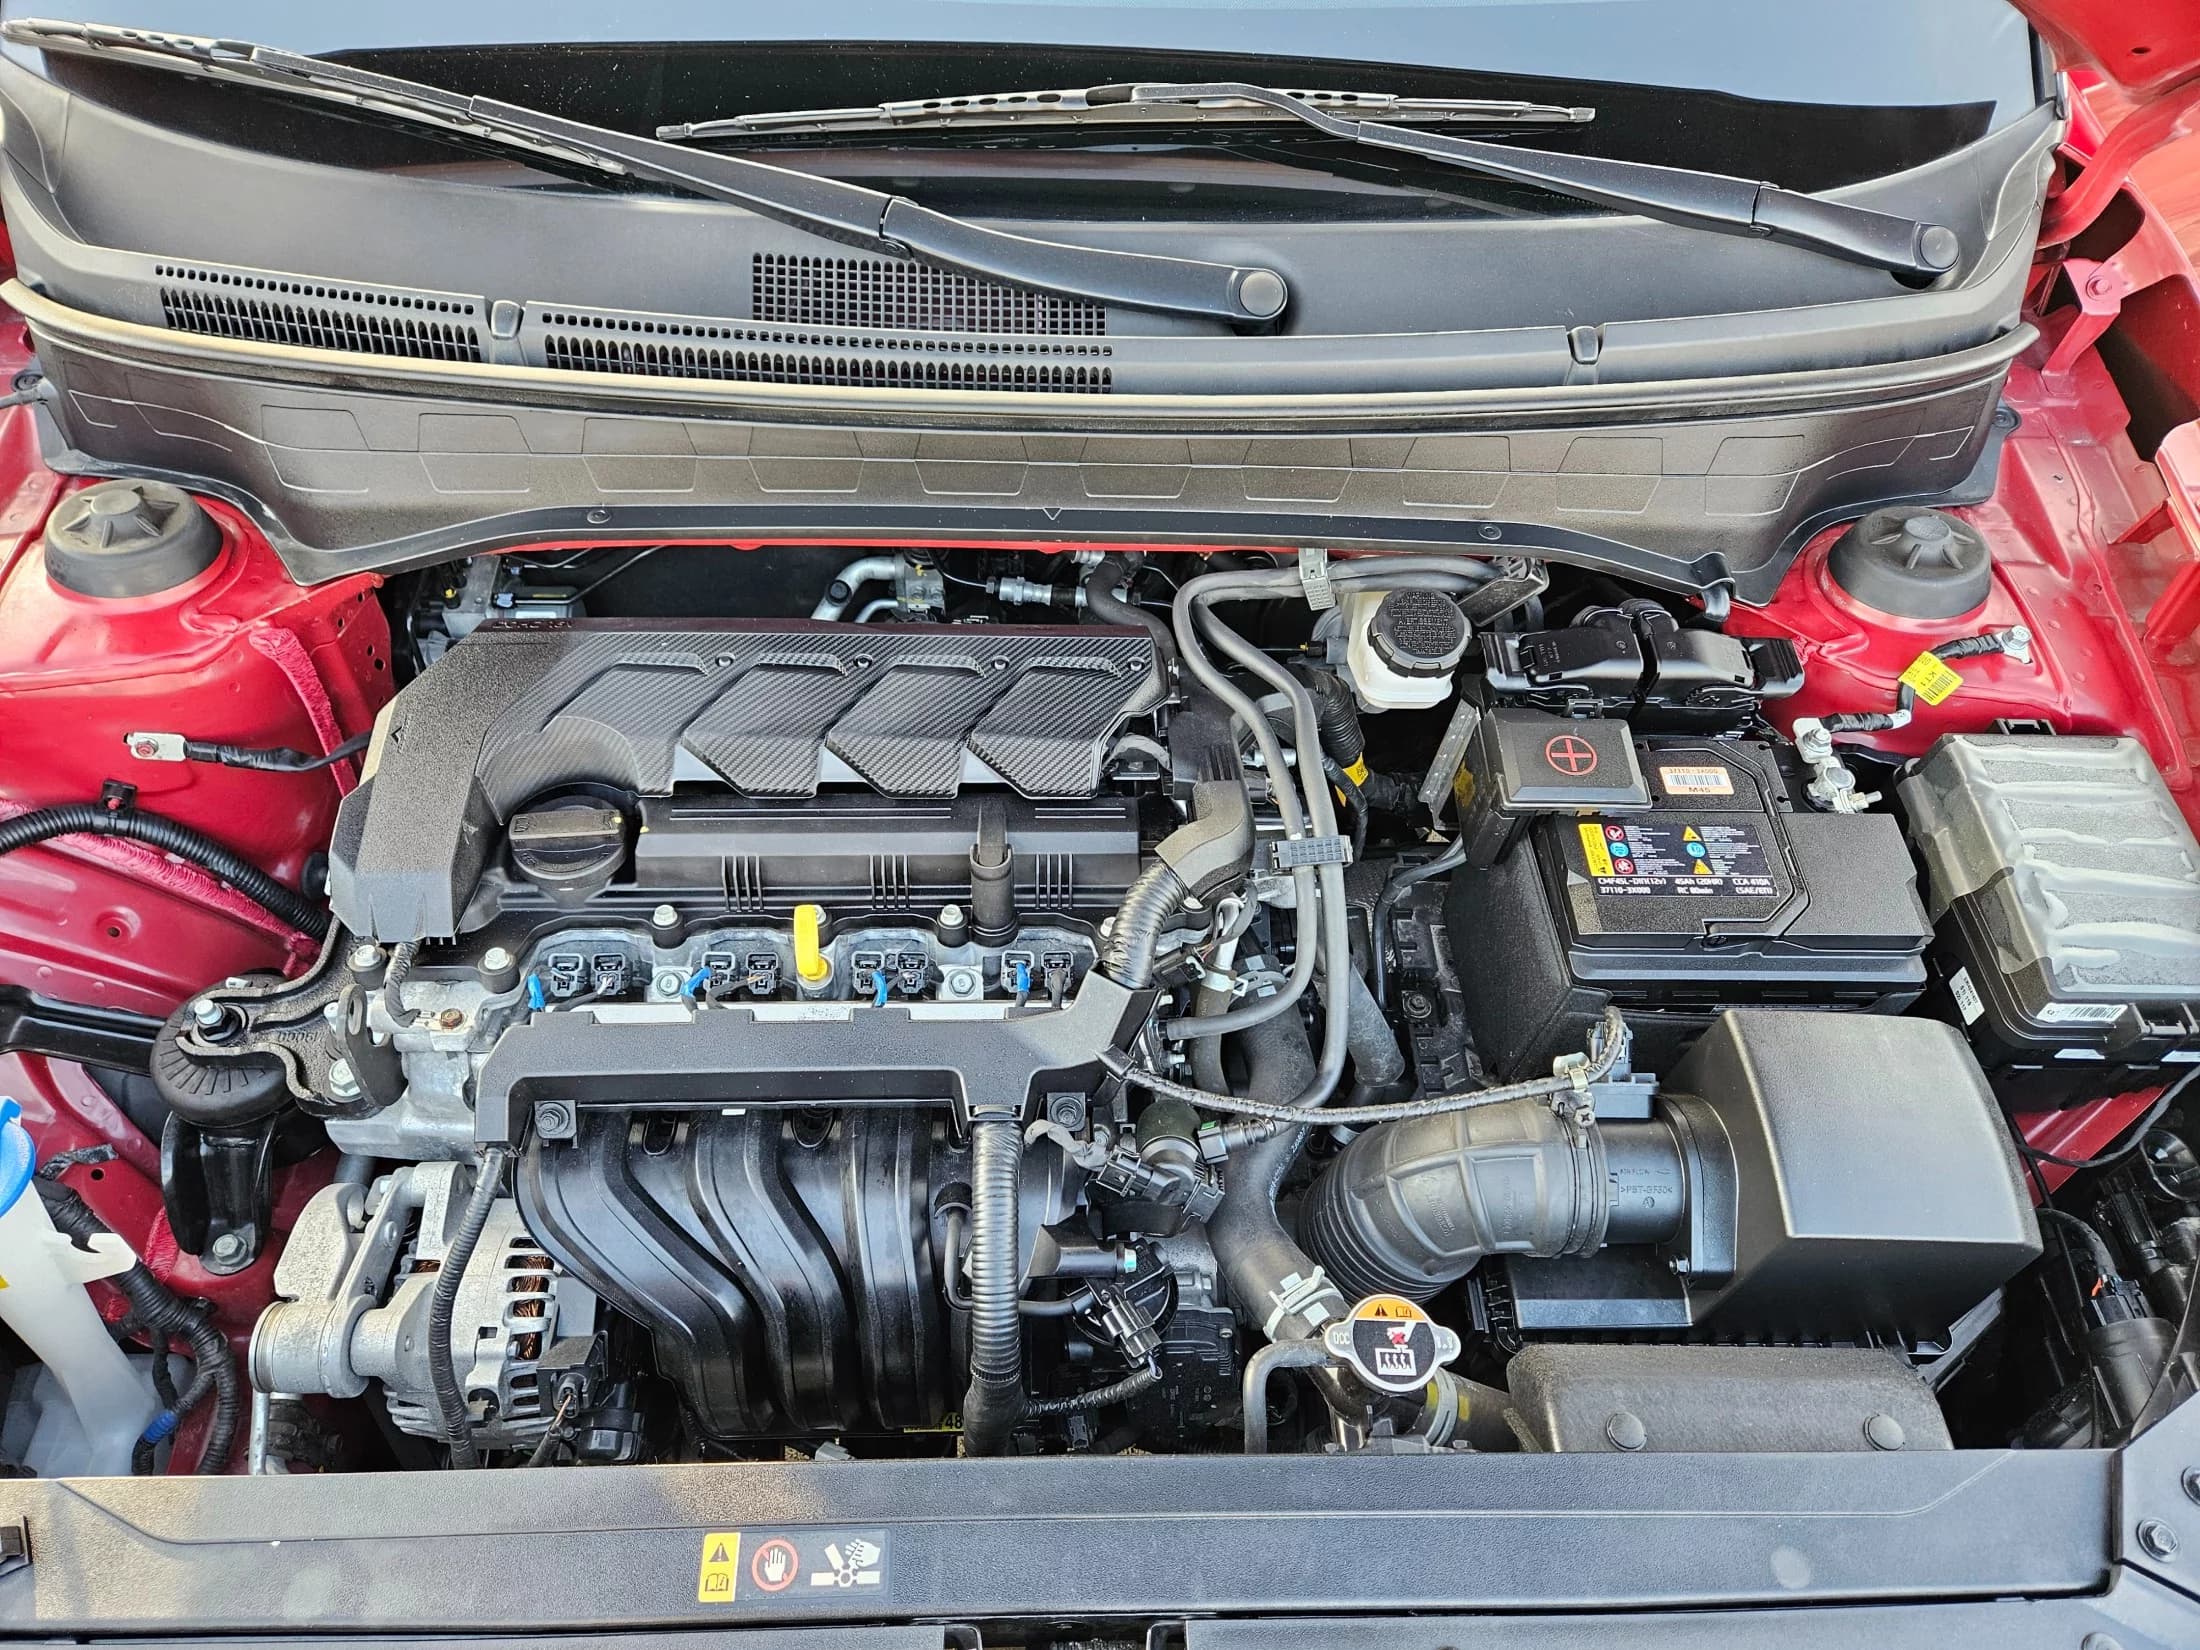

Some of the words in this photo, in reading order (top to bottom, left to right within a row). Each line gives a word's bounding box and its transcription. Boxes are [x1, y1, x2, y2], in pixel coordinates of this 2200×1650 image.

[1674, 877, 1696, 886] 45Ah
[1732, 878, 1750, 886] CCA
[1600, 886, 1651, 894] 37110-3X000
[1677, 886, 1689, 894] RC
